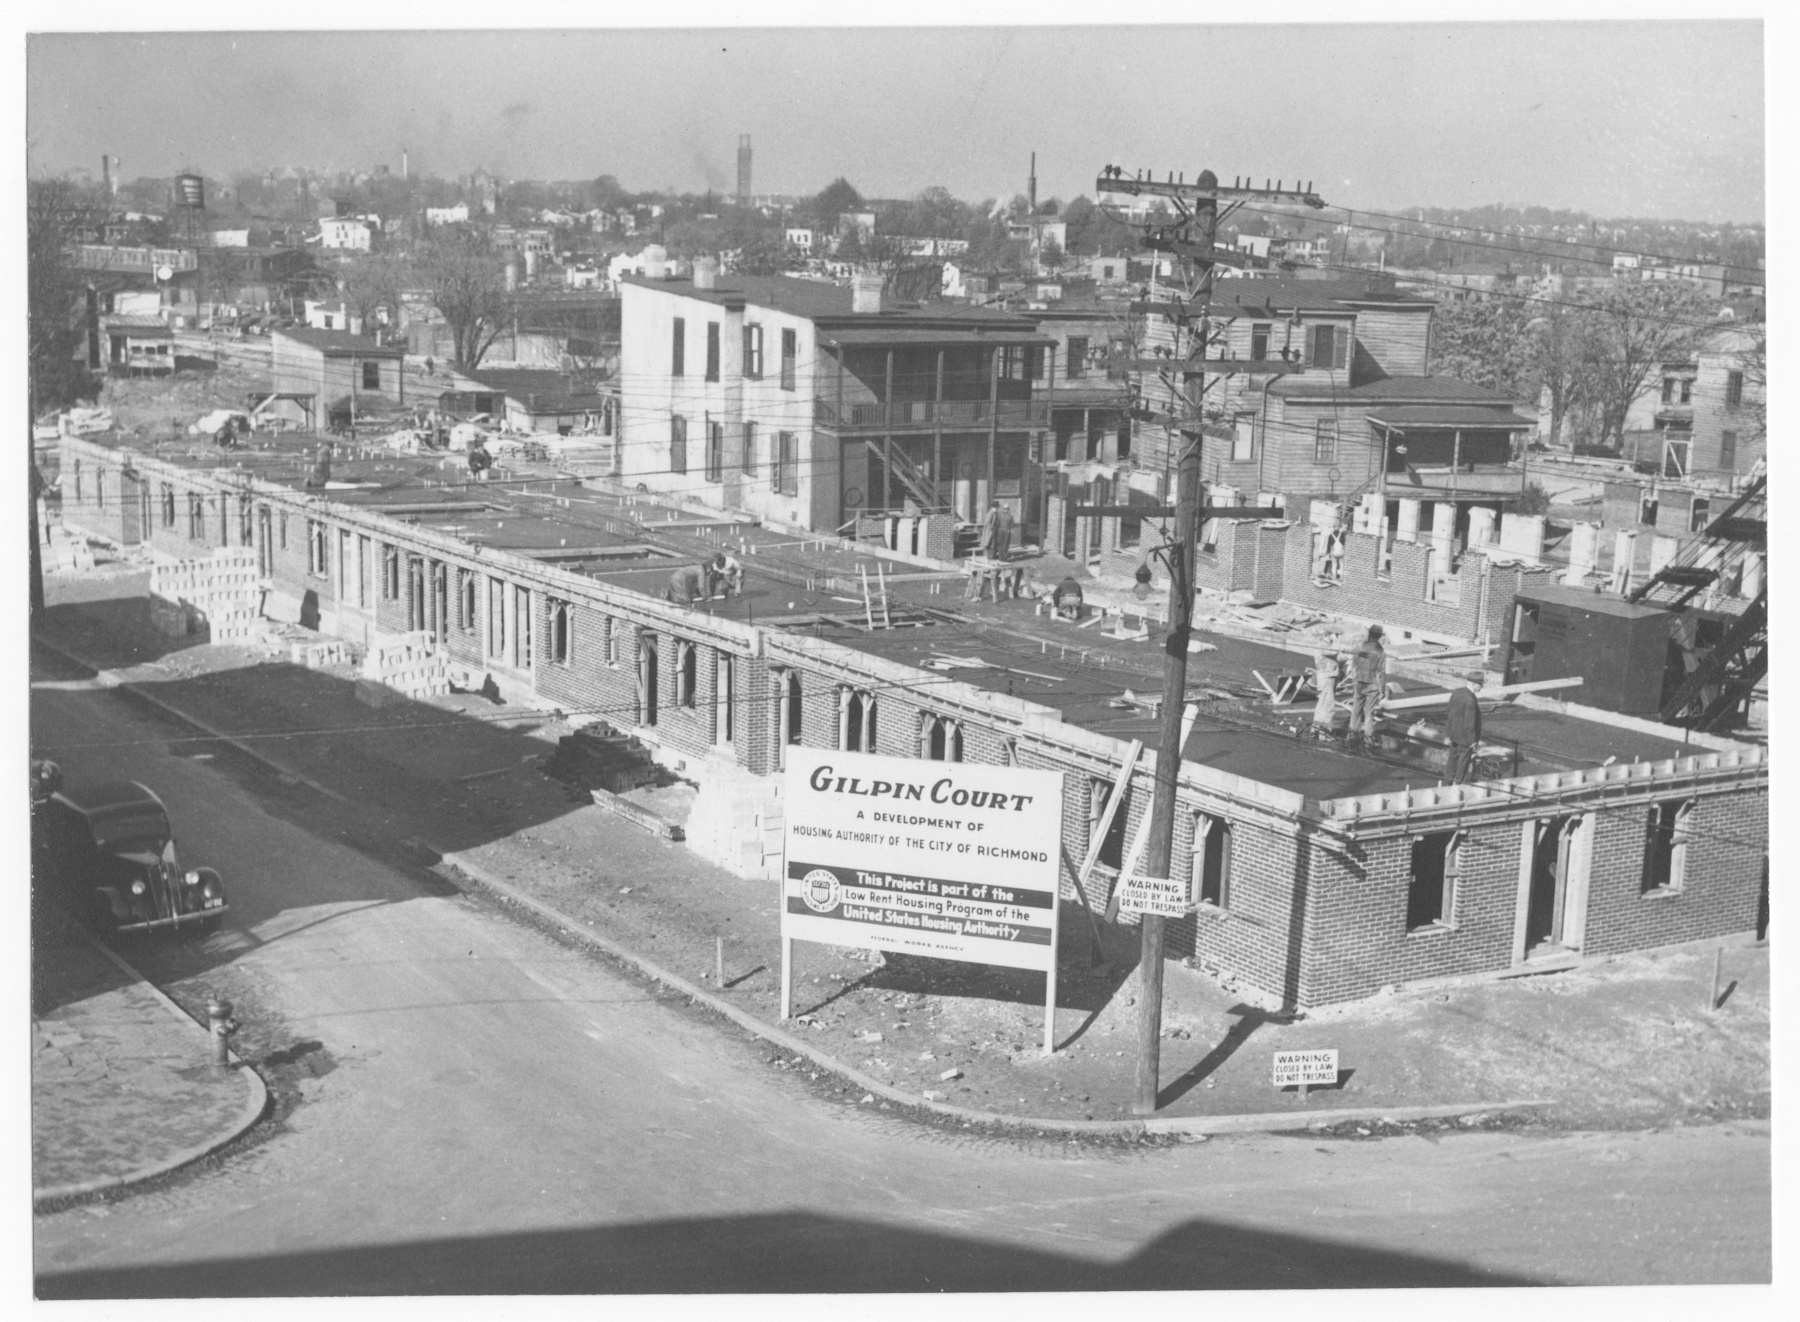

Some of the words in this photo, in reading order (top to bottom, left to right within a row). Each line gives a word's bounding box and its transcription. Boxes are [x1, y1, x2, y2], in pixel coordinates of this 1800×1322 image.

[810, 765, 925, 801] GILPIN
[930, 778, 1033, 812] COURT
[856, 810, 865, 819] A
[873, 812, 962, 829] DEVELOPMENT
[967, 822, 984, 831] OF
[793, 825, 833, 838] HOUSING
[836, 830, 885, 844] AUTHORITY
[888, 836, 901, 846] OF
[906, 838, 925, 849] THE
[929, 840, 953, 852] CITY
[957, 843, 971, 853] OF
[977, 845, 1048, 863] RICHMOND
[856, 872, 883, 886] This
[885, 875, 925, 892] Project
[927, 880, 939, 893] is
[941, 884, 969, 897] part
[972, 885, 988, 899] of
[991, 888, 1014, 902] the
[1127, 879, 1179, 893] WARNING
[1122, 889, 1148, 899] CLOSED
[1151, 892, 1162, 901] BY
[1165, 895, 1183, 903] LAW
[845, 888, 866, 901] Low
[870, 891, 893, 905] Rent
[896, 894, 943, 914] Housing
[946, 900, 993, 918] Program
[995, 907, 1008, 919] of
[1011, 908, 1030, 921] the
[1122, 898, 1131, 906] DO
[1133, 900, 1148, 909] NOT
[1151, 902, 1184, 914] TRESPASS
[843, 904, 883, 922] United
[884, 910, 921, 927] States
[921, 914, 963, 936] Housing
[963, 920, 1020, 941] Authority
[904, 939, 932, 948] WORKS
[1278, 1054, 1331, 1064] WARNING
[1275, 1065, 1300, 1073] CLOSED
[1303, 1064, 1312, 1072] BY
[1315, 1063, 1333, 1071] LAW
[1276, 1074, 1285, 1082] DO
[1286, 1073, 1299, 1082] NOT
[1302, 1072, 1335, 1081] TRESPASS
